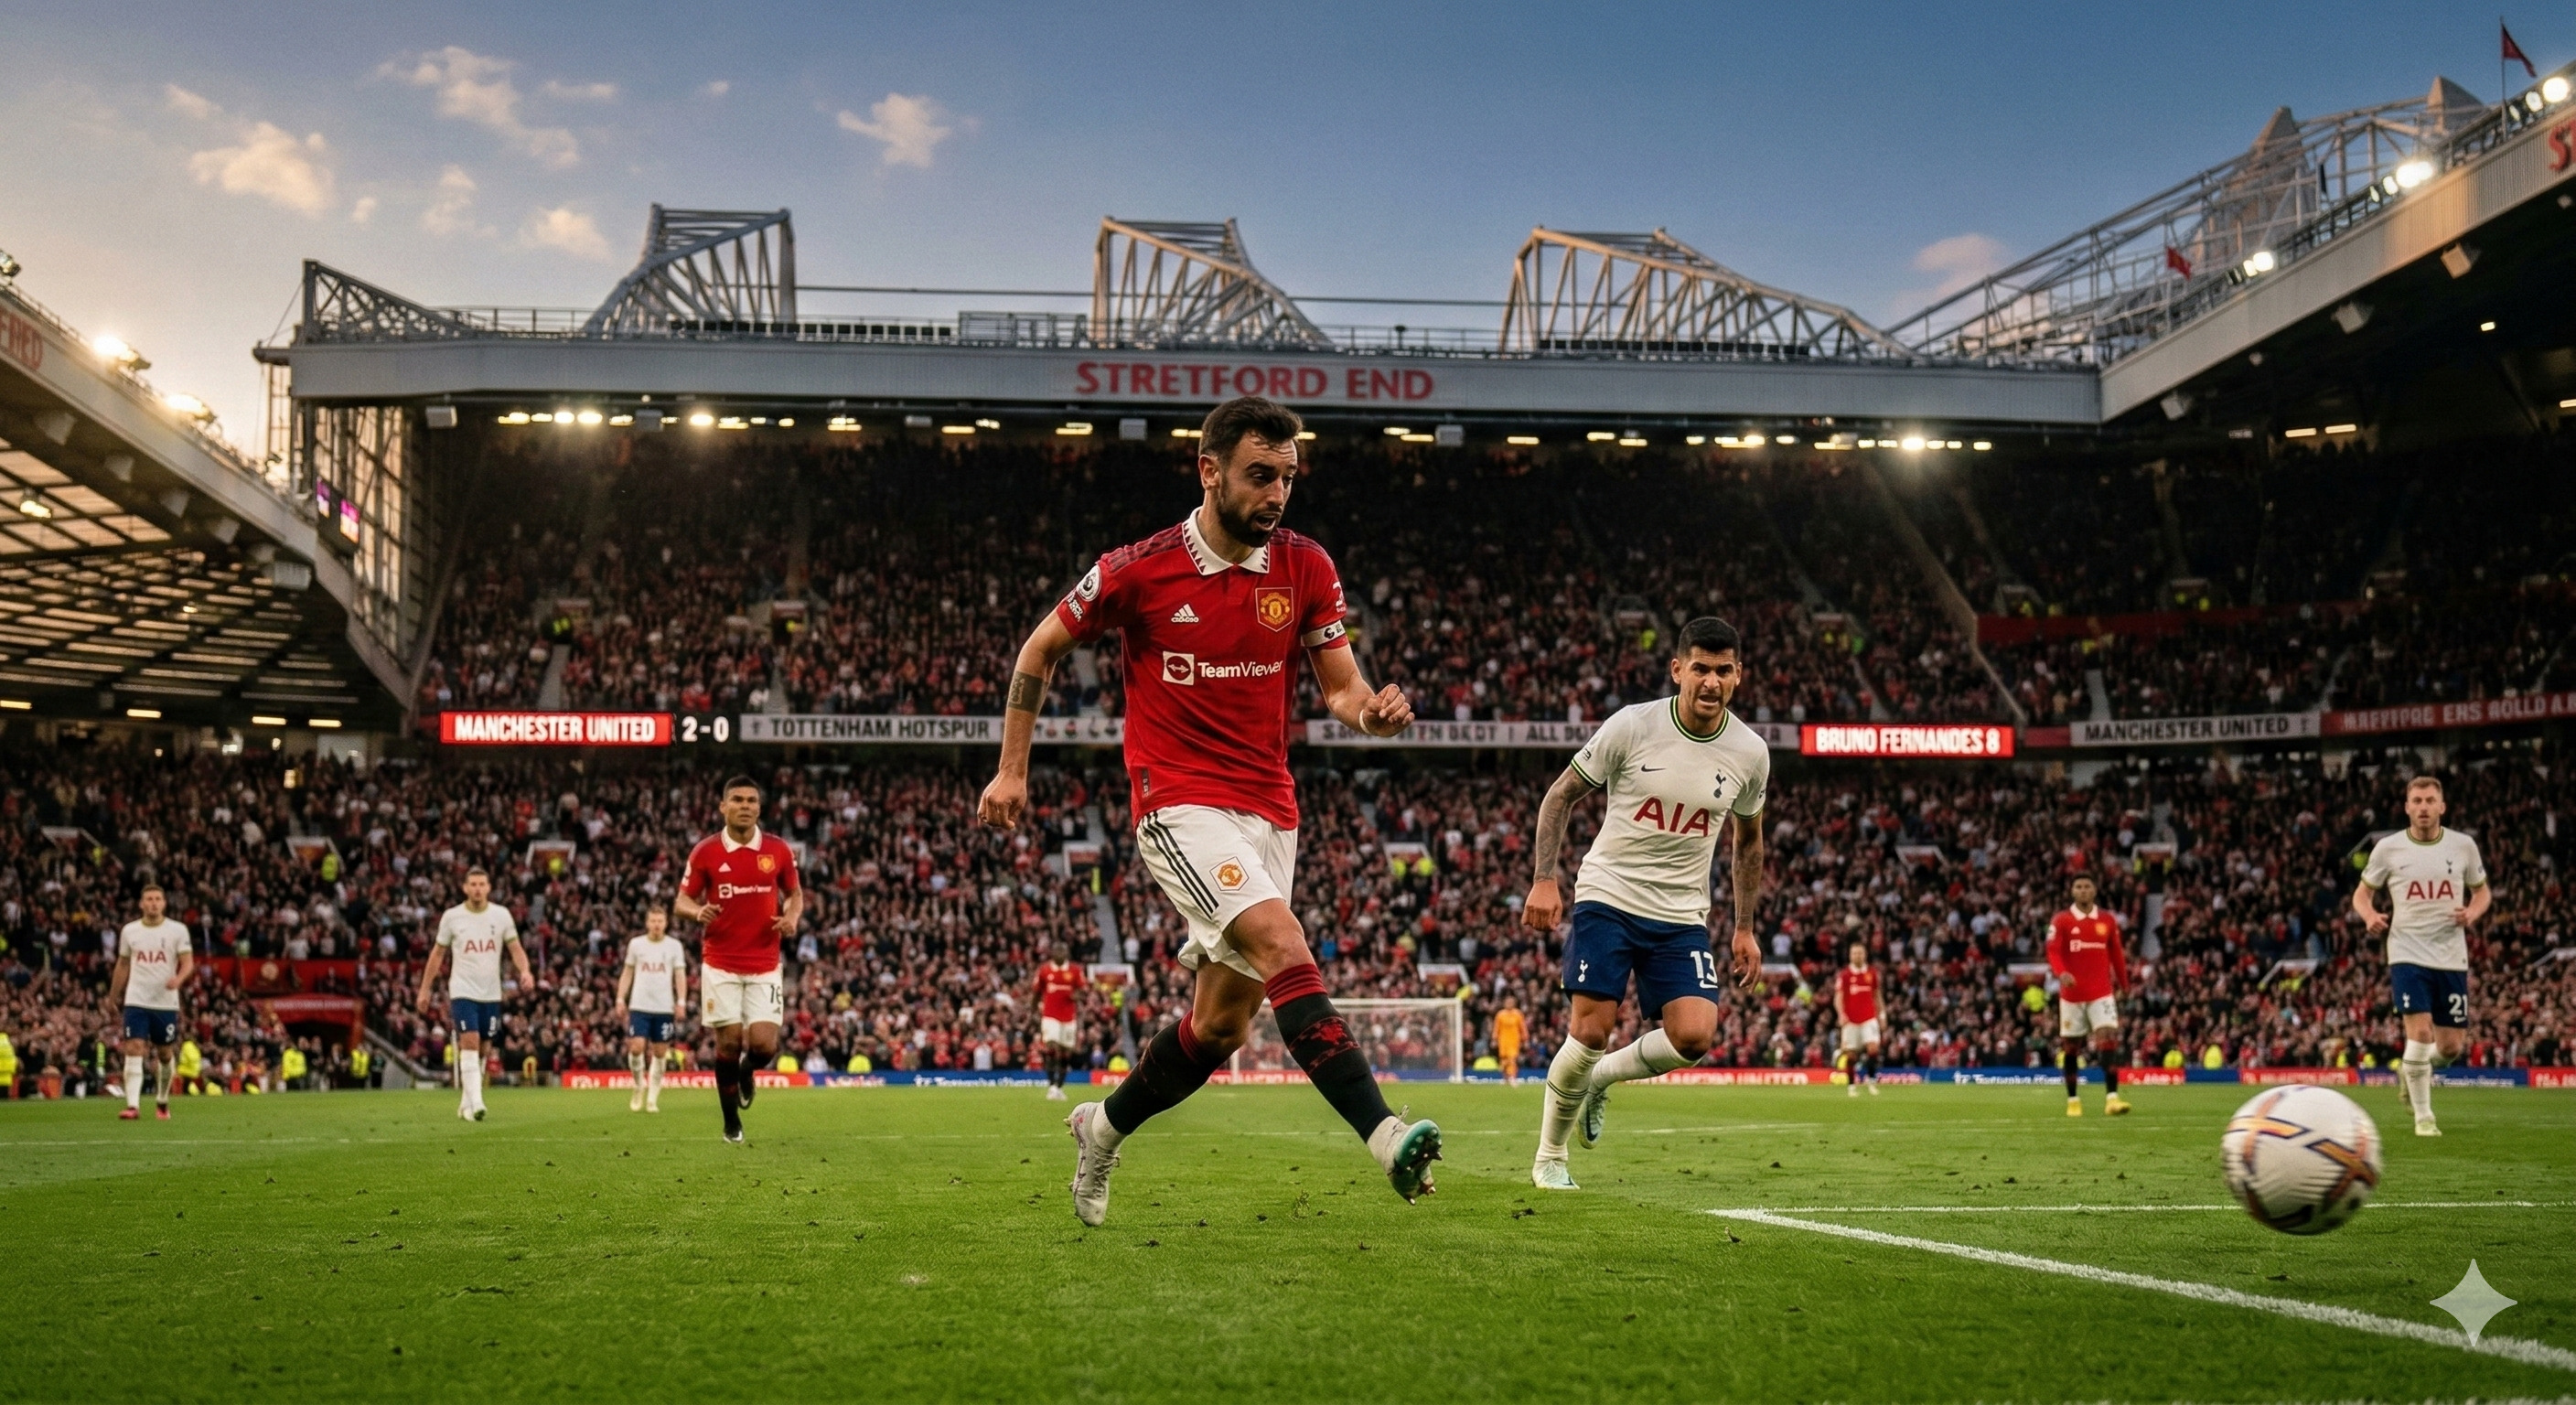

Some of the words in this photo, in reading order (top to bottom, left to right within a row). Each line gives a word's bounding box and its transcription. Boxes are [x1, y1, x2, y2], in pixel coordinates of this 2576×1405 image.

[1076, 361, 1327, 398] STRETFORD
[1347, 368, 1433, 401] END
[1197, 660, 1283, 678] TeamViewer
[455, 715, 583, 743] MANCHESTER
[586, 715, 657, 743] UNITED
[771, 718, 892, 738] TOTTENHAM
[898, 719, 989, 739] HOTSPUR
[1816, 727, 1877, 753] BRUNO
[1880, 727, 1983, 754] FERNANDES
[1986, 728, 2001, 754] 8
[2085, 720, 2212, 742] MANCHESTER
[2219, 717, 2288, 736] UNITED
[1633, 797, 1710, 838] AIA
[2406, 880, 2454, 900] AIA
[136, 950, 166, 963] AIA
[465, 939, 497, 953] AIA
[1690, 950, 1718, 984] 13
[2448, 993, 2468, 1016] 21
